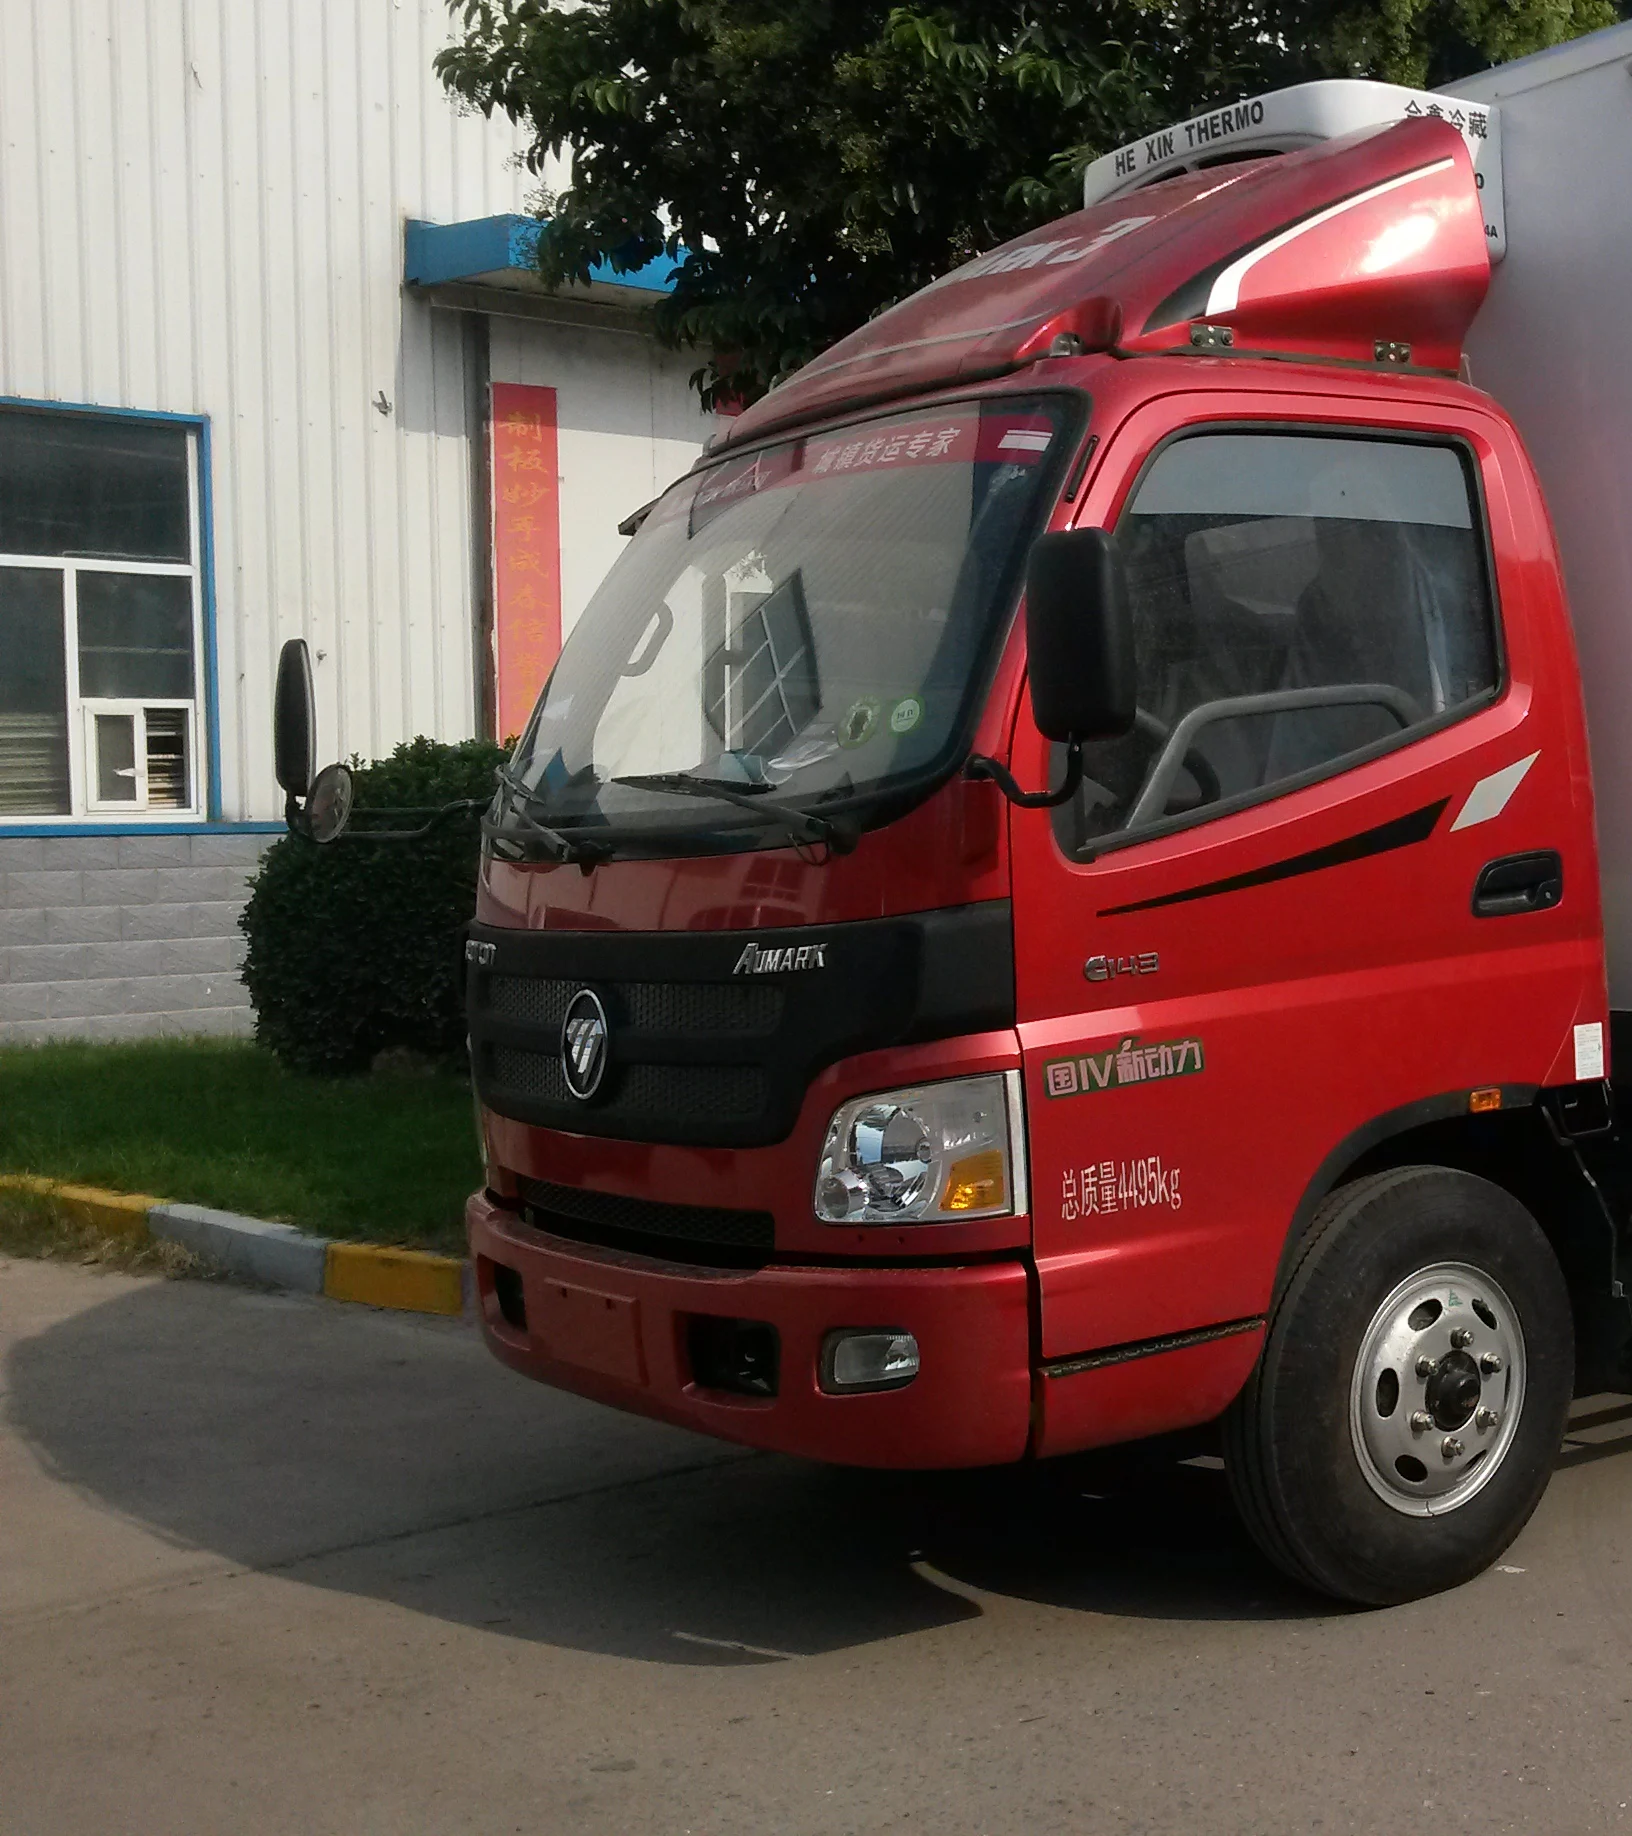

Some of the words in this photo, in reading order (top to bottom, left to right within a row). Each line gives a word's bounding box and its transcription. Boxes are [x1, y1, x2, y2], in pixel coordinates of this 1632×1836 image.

[1115, 149, 1136, 177] HE
[1145, 131, 1175, 164] XIN
[1185, 100, 1264, 148] THERMO
[732, 942, 828, 975] AUMARK
[1061, 1156, 1182, 1220] 总质量4495kg
